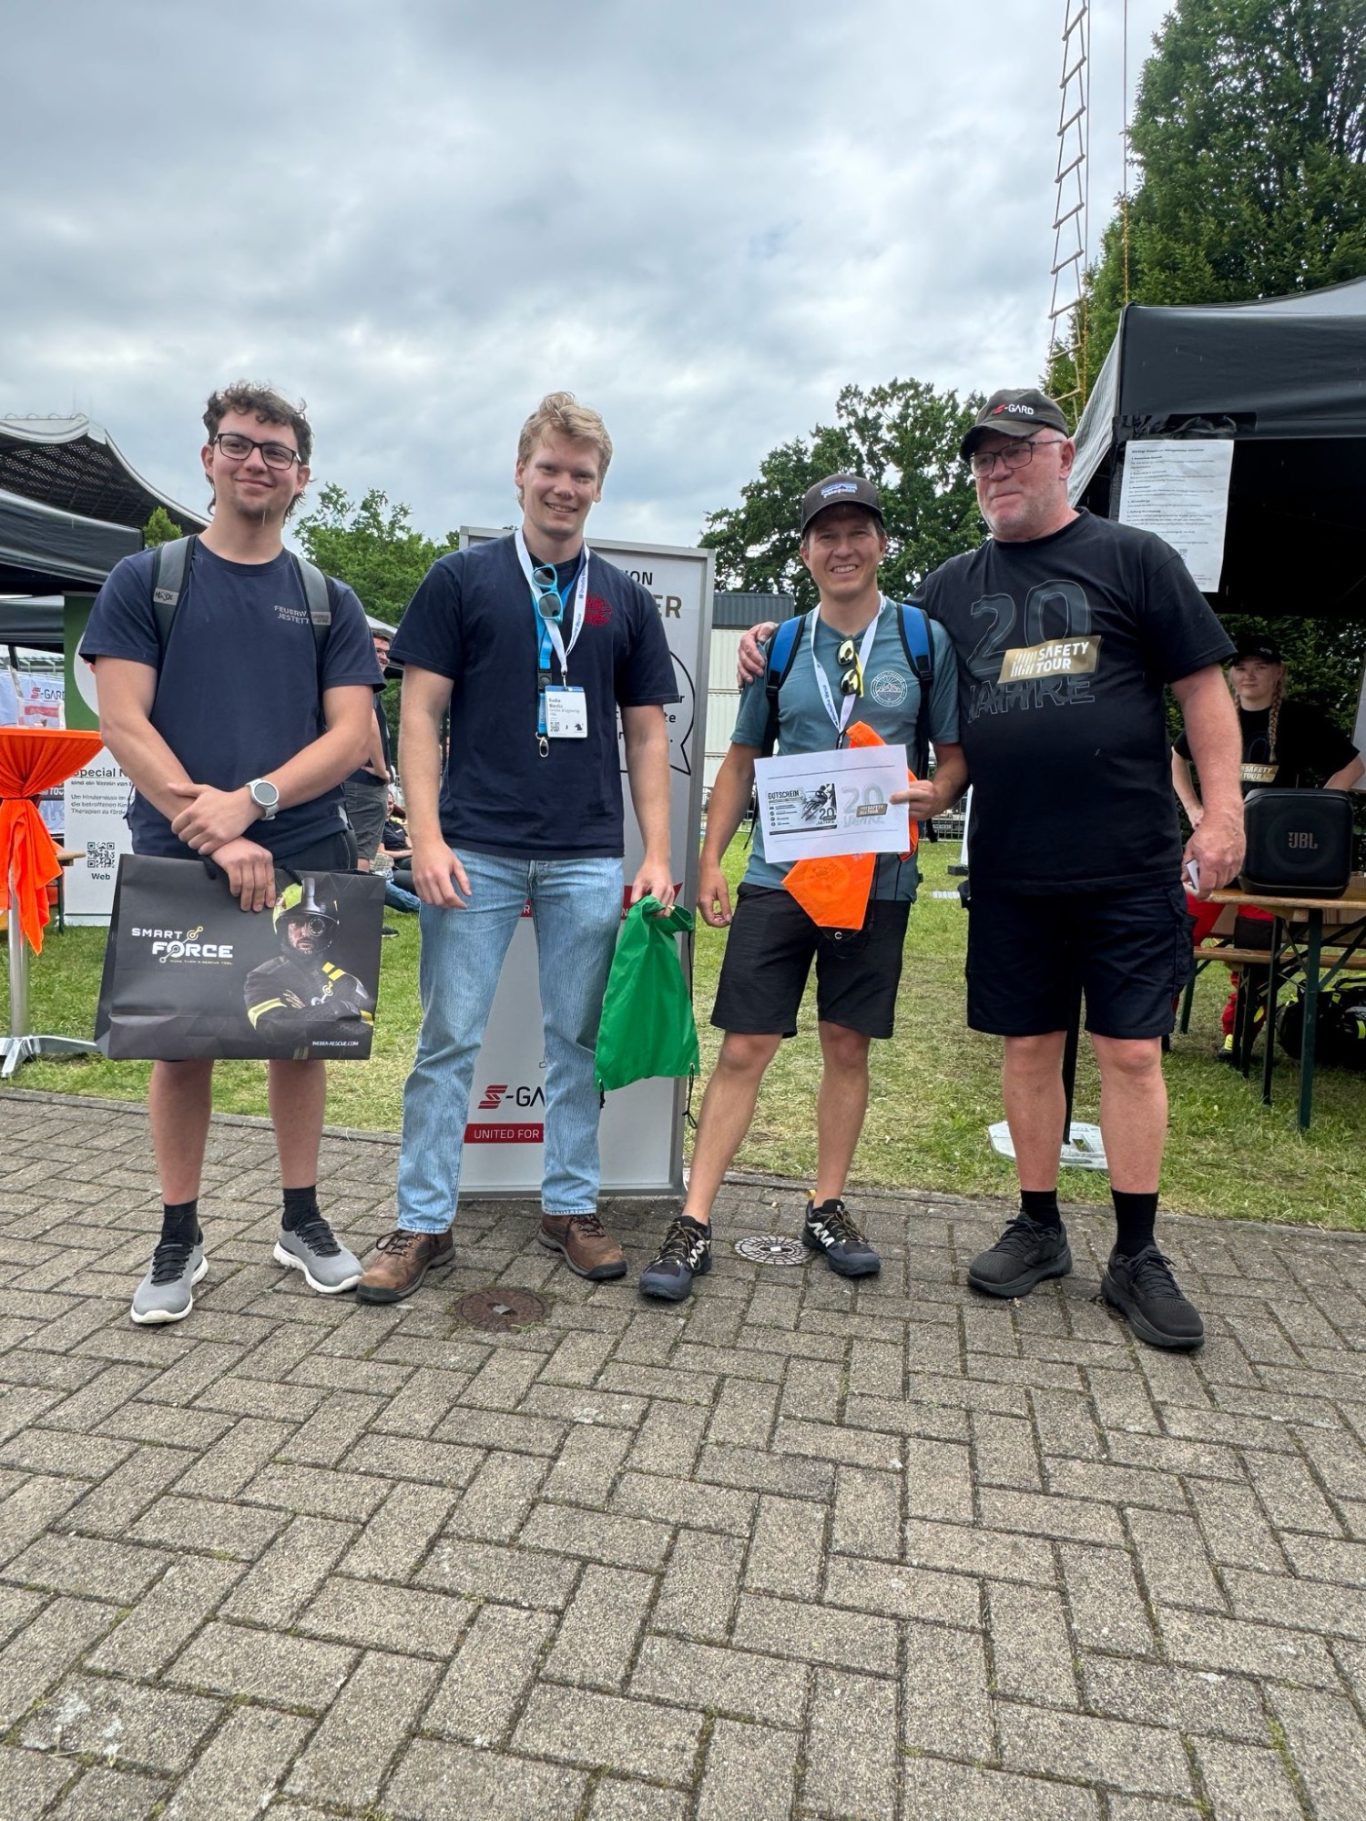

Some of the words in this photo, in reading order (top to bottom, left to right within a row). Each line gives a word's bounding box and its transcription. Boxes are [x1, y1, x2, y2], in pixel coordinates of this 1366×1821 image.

[992, 404, 1034, 415] S-GARD
[624, 570, 653, 585] ON
[1038, 641, 1090, 661] SAFETY
[1035, 657, 1072, 674] TOUR
[31, 687, 65, 700] S-GAR
[1288, 832, 1318, 849] JBL
[131, 928, 183, 939] SMART
[152, 941, 234, 958] FORCE
[473, 1129, 514, 1139] UNITED
[517, 1129, 540, 1139] FOR
